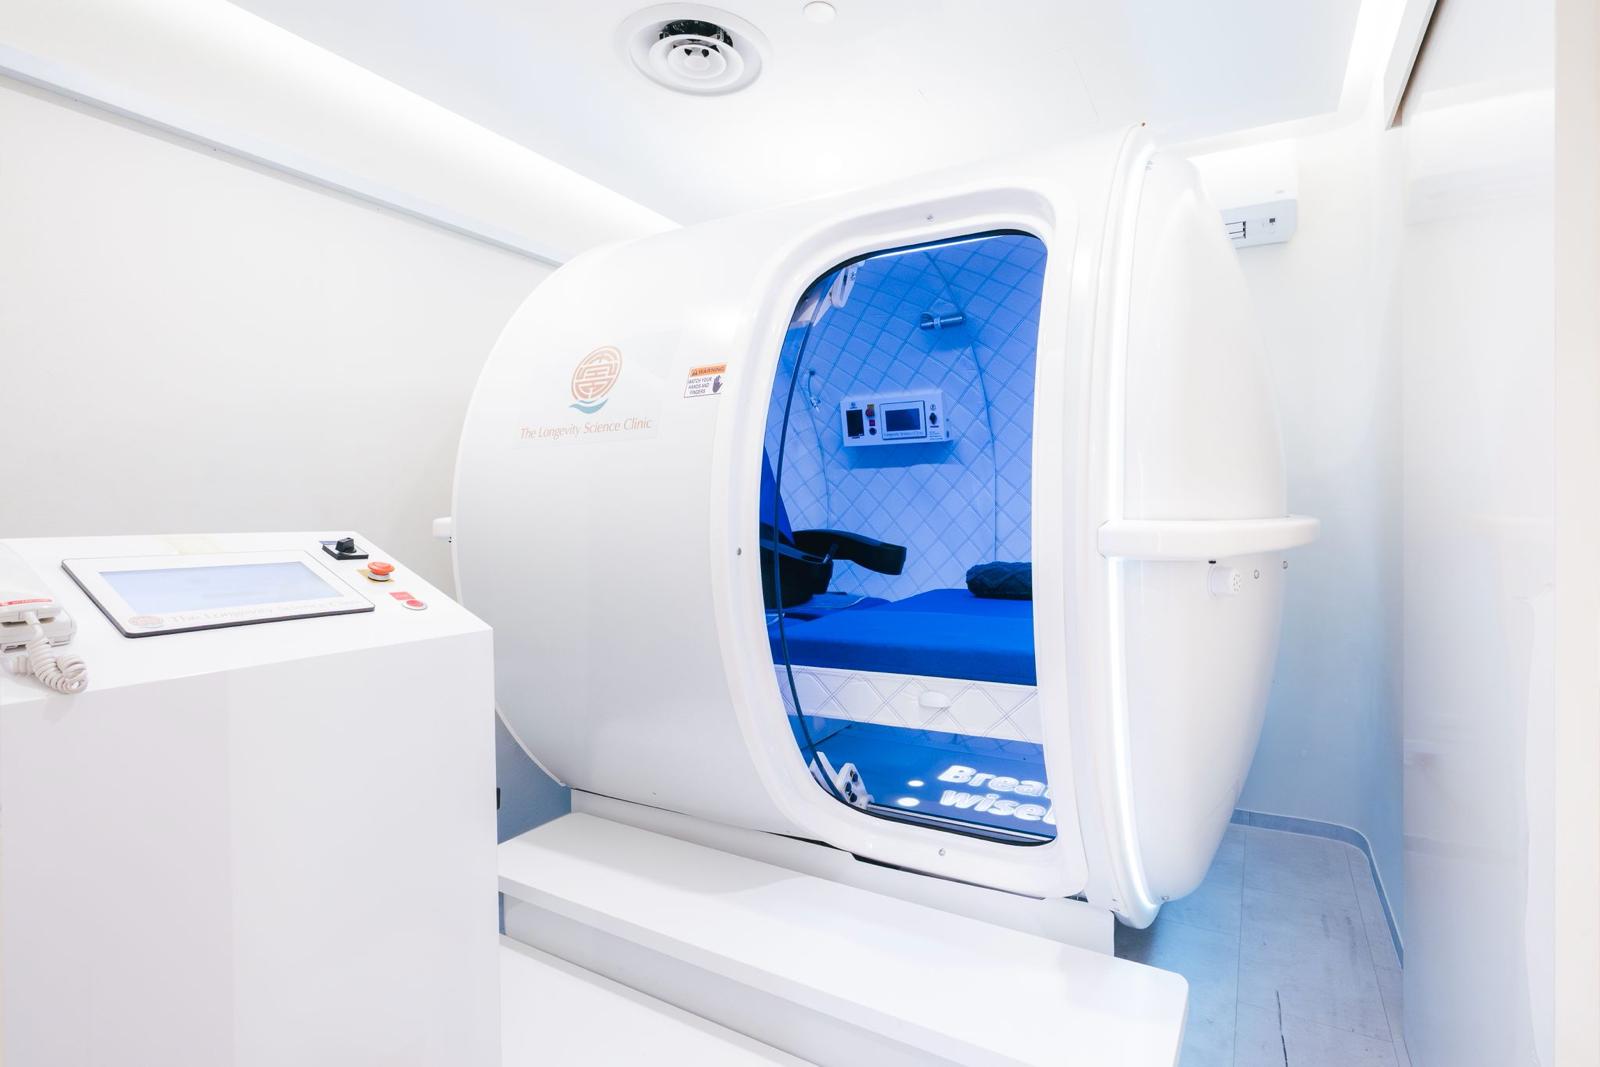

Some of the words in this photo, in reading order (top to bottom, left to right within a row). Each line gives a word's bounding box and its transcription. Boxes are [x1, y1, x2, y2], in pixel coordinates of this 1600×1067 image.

[520, 425, 537, 440] The
[538, 423, 580, 441] Longevity
[583, 421, 621, 434] Science
[623, 416, 653, 431] Clinic
[937, 764, 1050, 799] Brea
